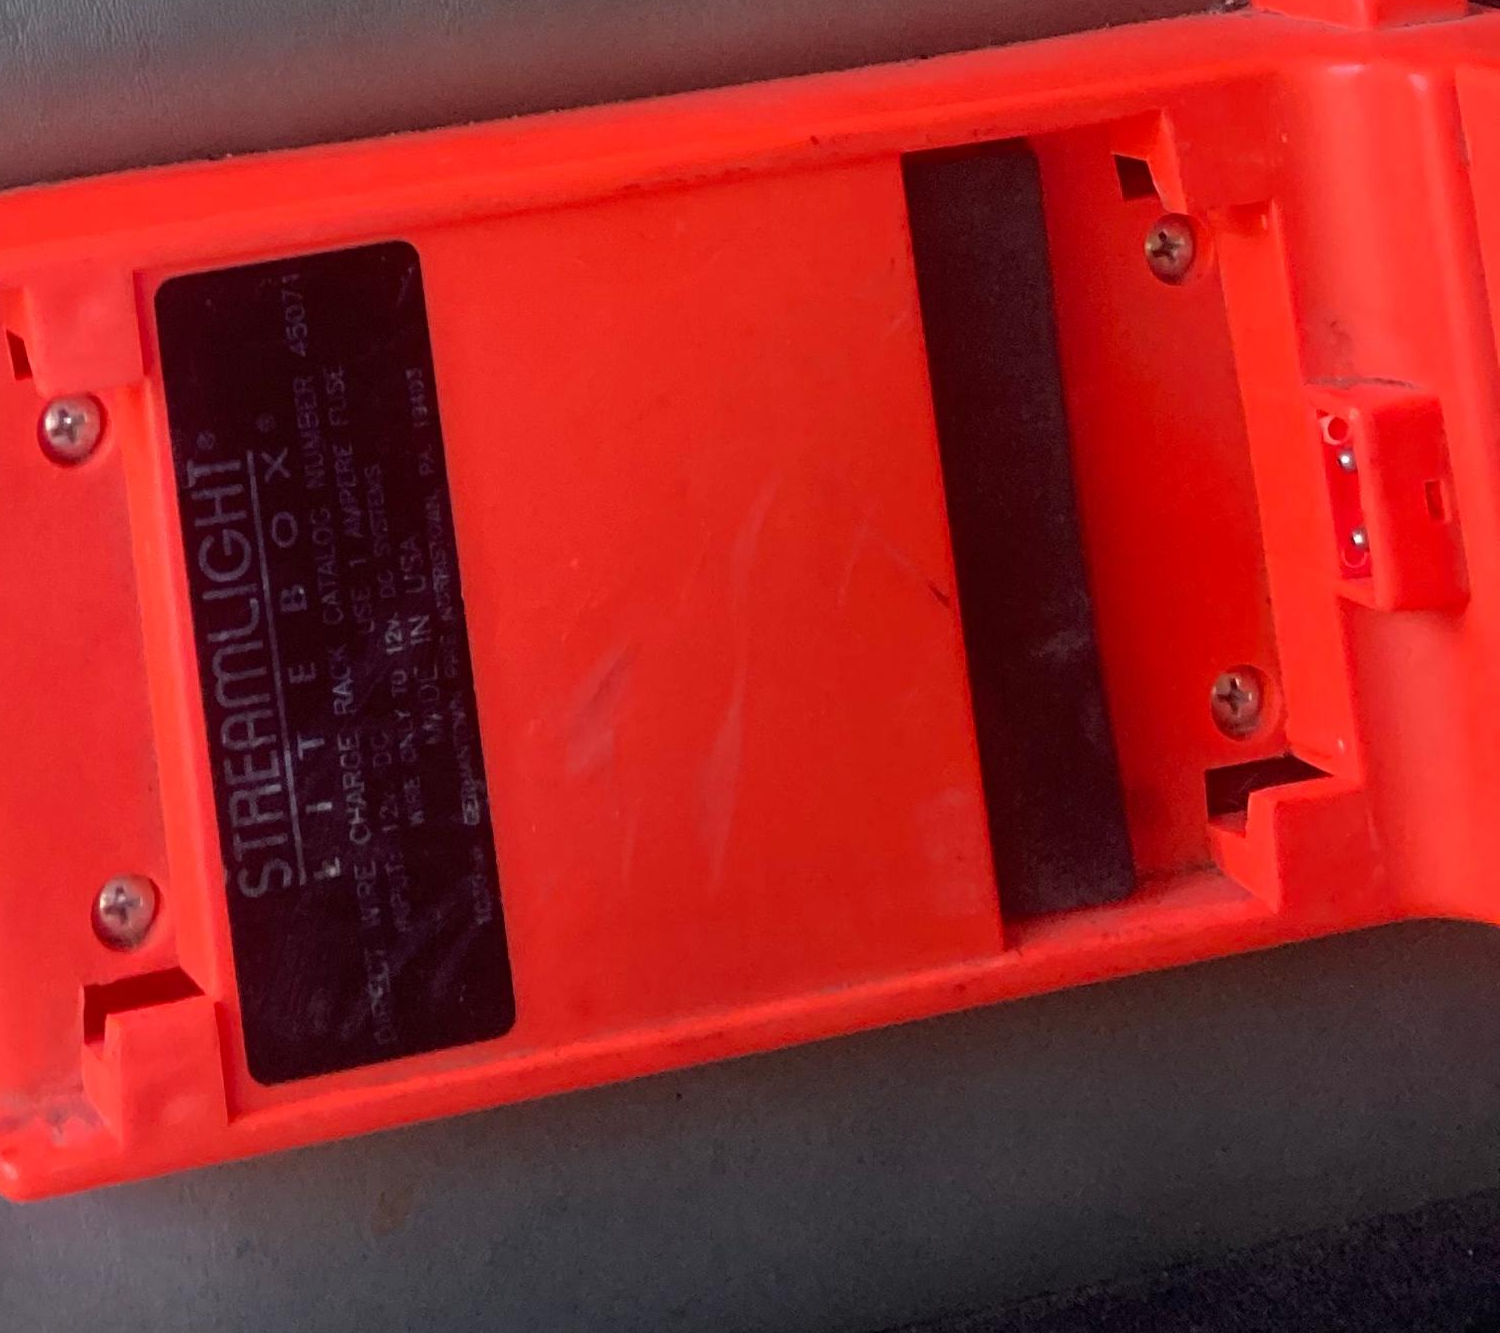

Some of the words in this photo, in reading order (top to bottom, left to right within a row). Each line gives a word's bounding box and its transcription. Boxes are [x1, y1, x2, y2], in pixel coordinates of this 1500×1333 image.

[291, 373, 328, 489] NUMBER
[332, 441, 363, 539] AMPERE
[363, 463, 392, 557] SYSTEMS
[308, 506, 345, 624] CATALOG
[376, 569, 396, 598] DC
[397, 533, 426, 593] USA
[350, 585, 375, 634] USE
[407, 614, 433, 644] IN
[183, 452, 296, 899] STREAMLIGHT
[325, 642, 357, 715] RACK
[388, 667, 408, 697] TO
[414, 663, 447, 745] MADE
[368, 730, 392, 767] DC
[394, 707, 417, 763] ONLY
[336, 729, 372, 845] CHARGE
